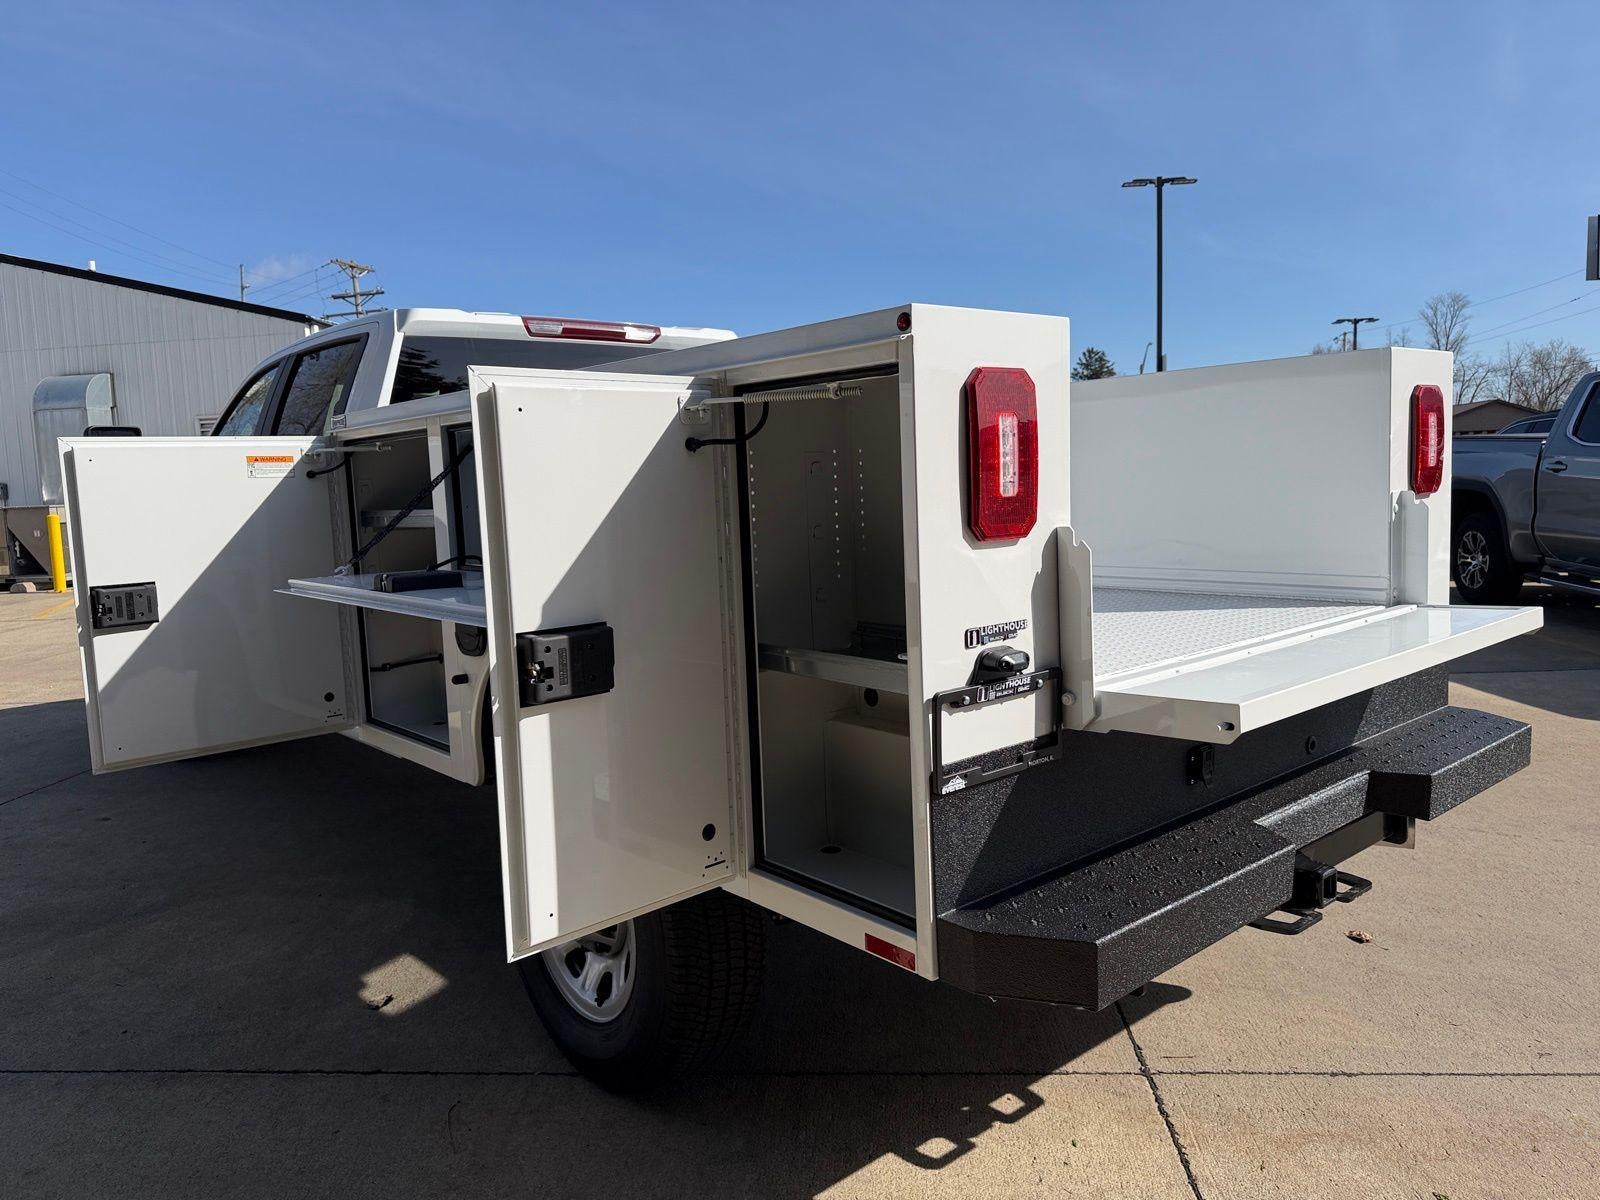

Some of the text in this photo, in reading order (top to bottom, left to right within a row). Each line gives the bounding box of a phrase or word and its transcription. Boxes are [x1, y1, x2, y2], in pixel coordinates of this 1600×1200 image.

[980, 619, 1028, 636] LIGHTHOUSE
[990, 676, 1031, 692] LIGHTHOUSE
[996, 689, 1014, 697] BUICK
